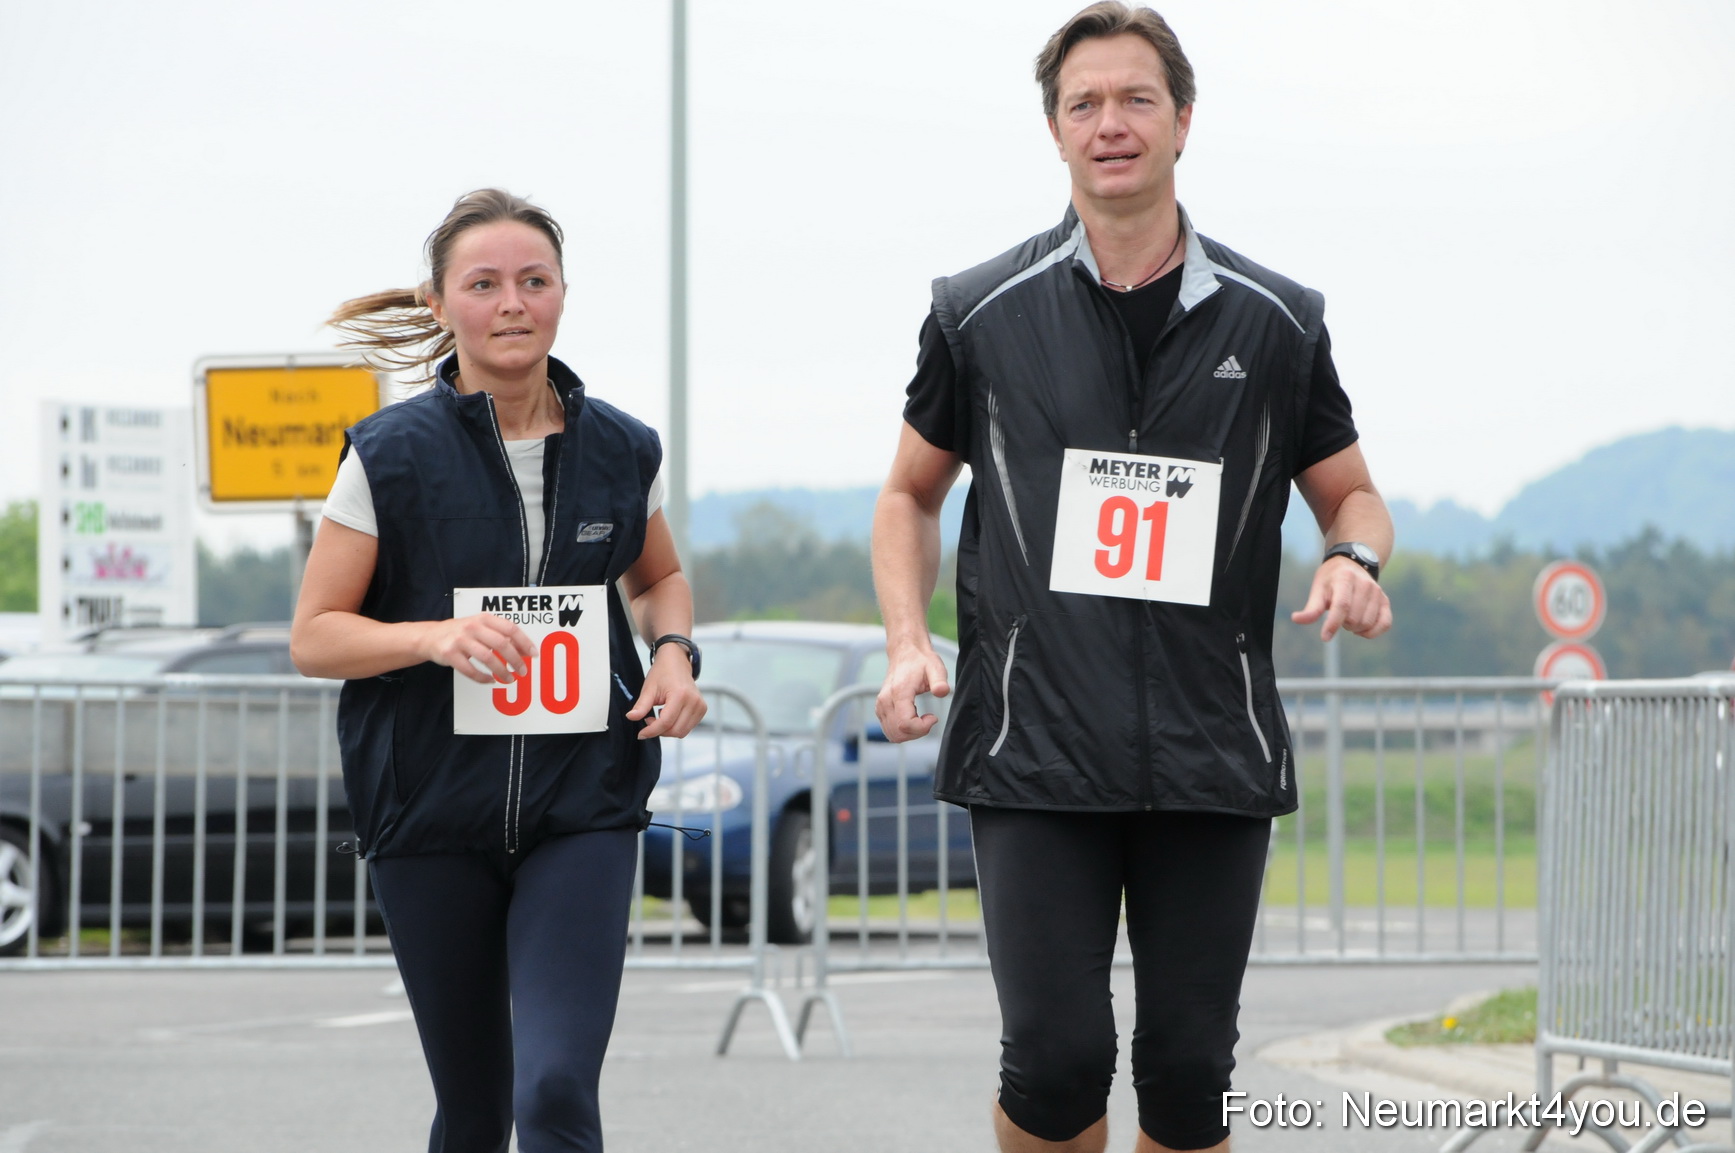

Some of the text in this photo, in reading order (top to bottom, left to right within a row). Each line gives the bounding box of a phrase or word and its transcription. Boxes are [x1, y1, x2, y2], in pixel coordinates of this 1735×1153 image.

[1213, 370, 1247, 379] adidas
[1089, 458, 1161, 480] MEYER
[1089, 475, 1161, 493] WERBUNG
[1094, 495, 1169, 582] 91
[481, 595, 553, 611] MEYER
[1553, 583, 1589, 619] 60
[492, 630, 579, 717] 90
